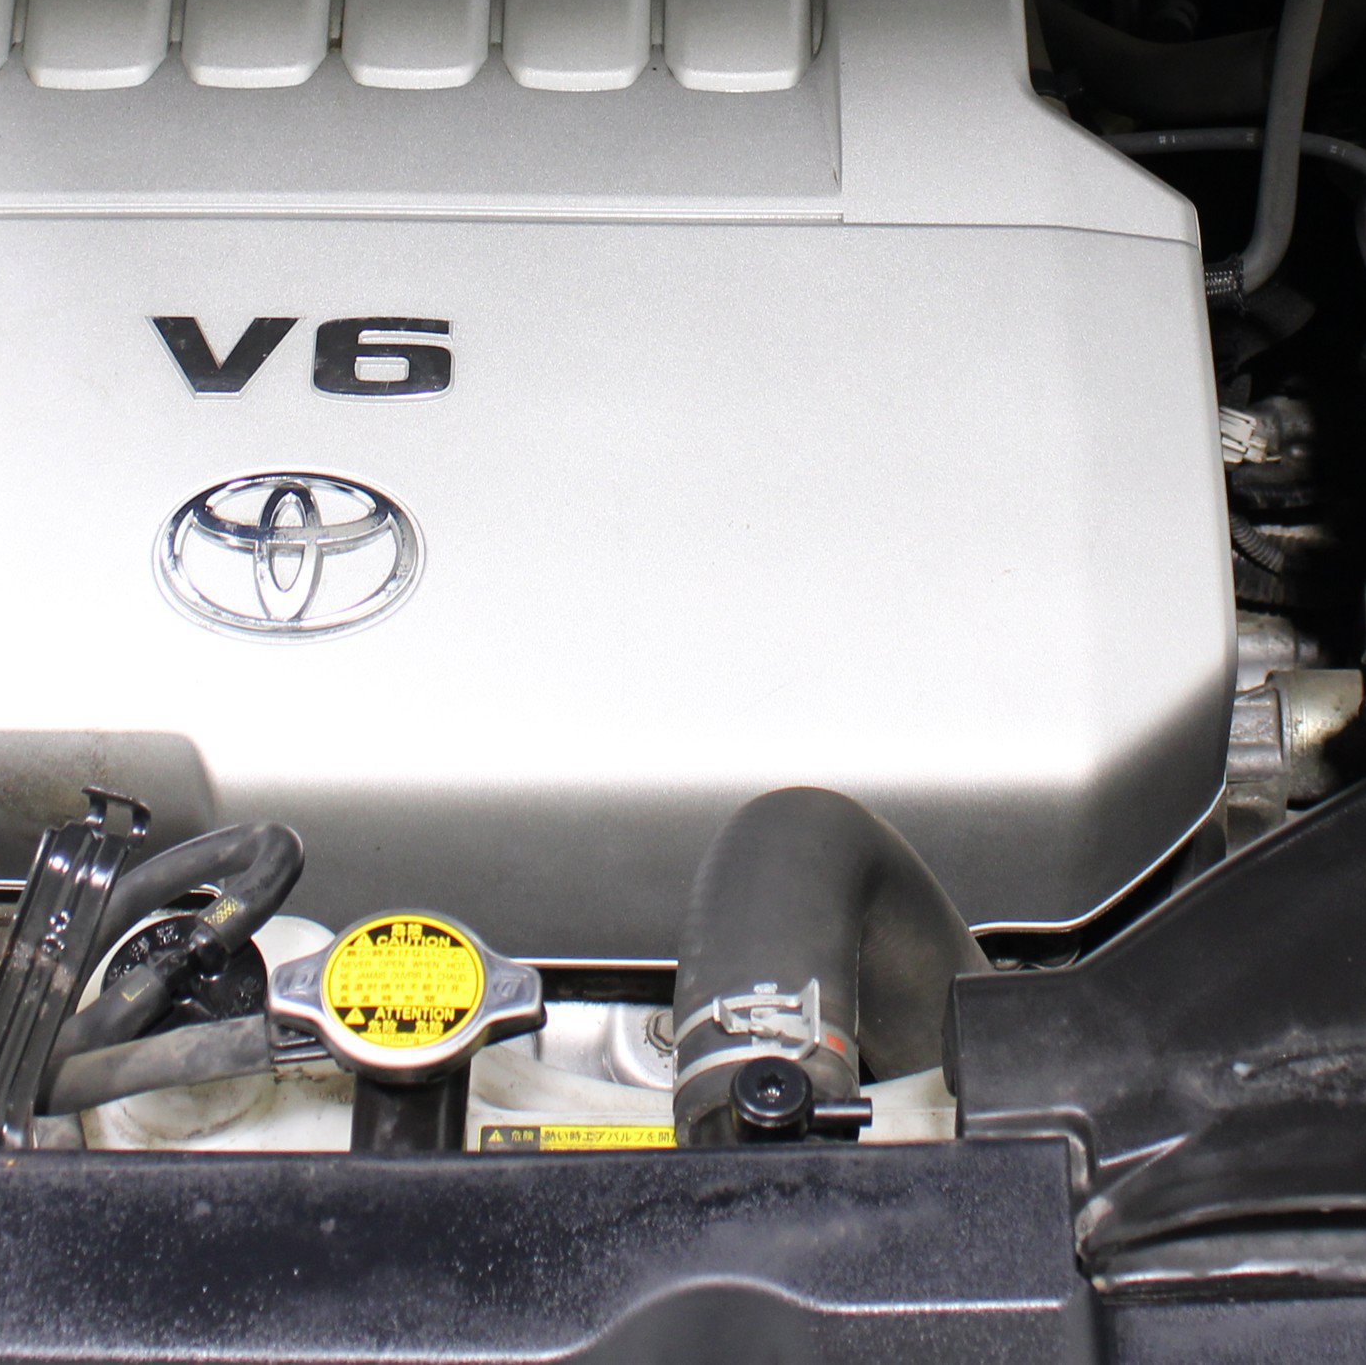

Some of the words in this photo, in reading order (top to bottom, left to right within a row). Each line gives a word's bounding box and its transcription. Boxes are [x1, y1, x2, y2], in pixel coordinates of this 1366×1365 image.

[145, 316, 455, 405] V6
[376, 936, 451, 948] CAUTION
[374, 1007, 456, 1021] ATTENTION
